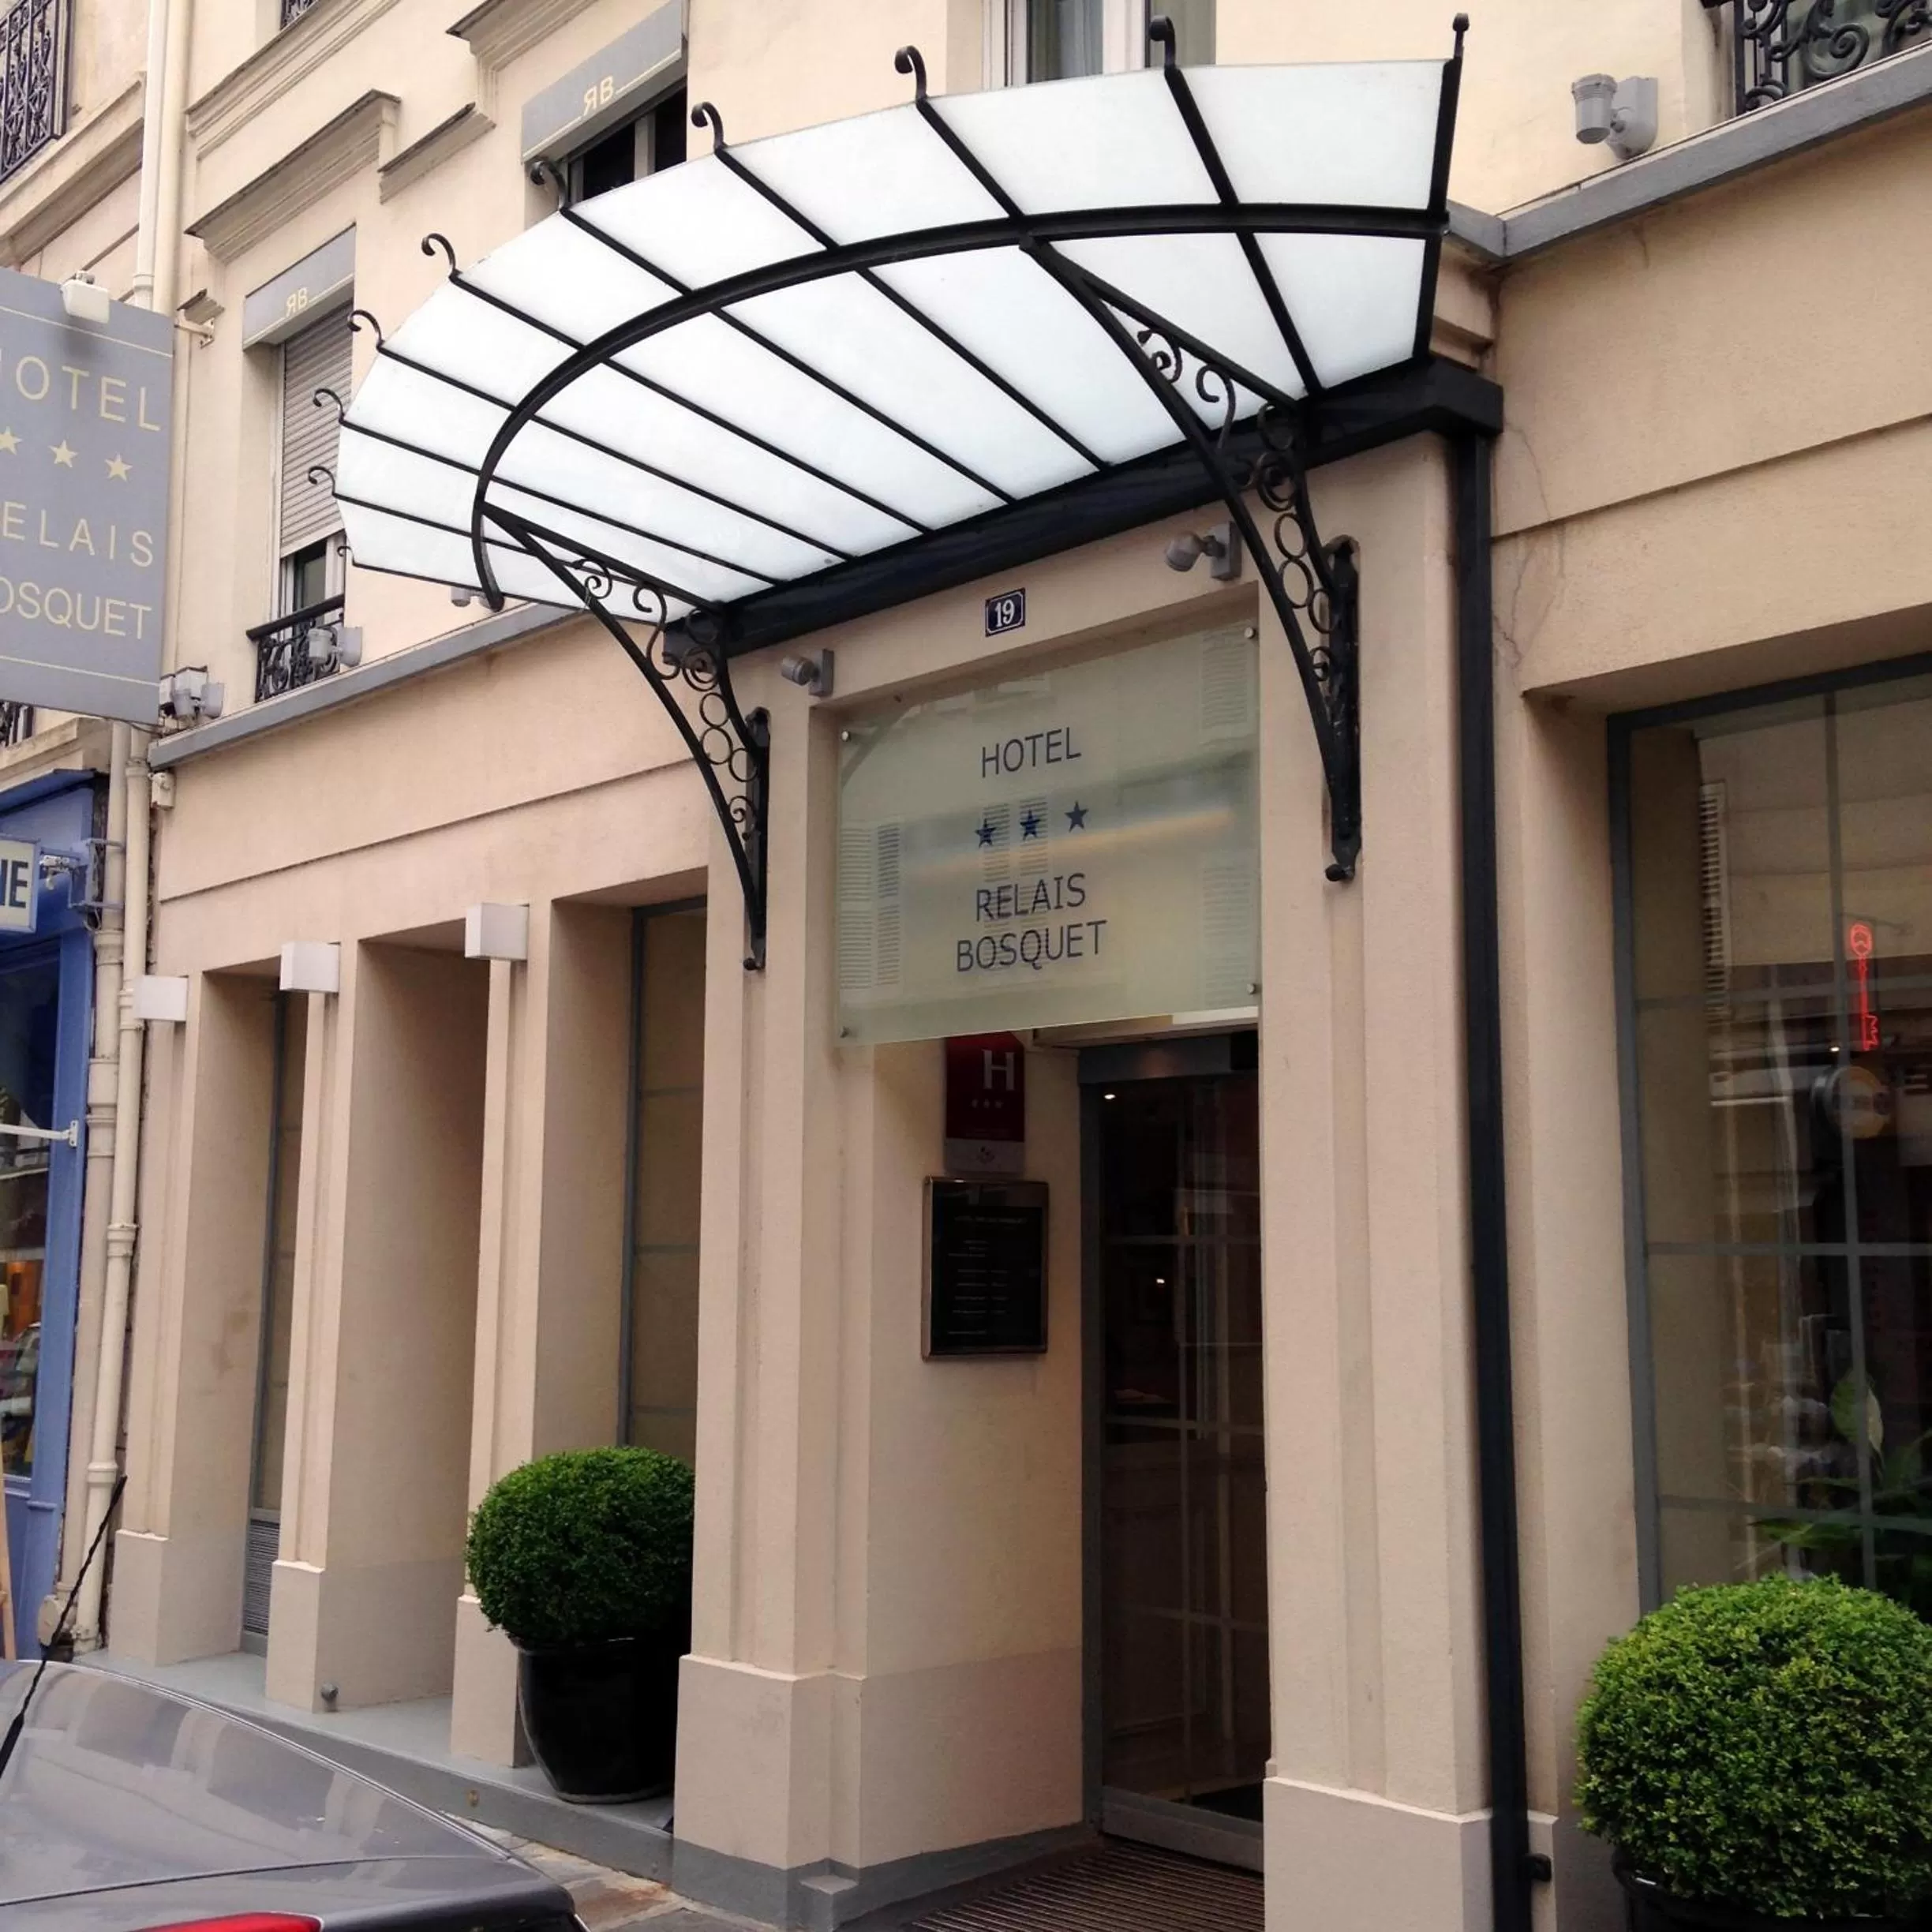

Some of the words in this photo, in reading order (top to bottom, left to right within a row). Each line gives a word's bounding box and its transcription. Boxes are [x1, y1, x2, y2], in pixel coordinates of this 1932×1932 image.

[0, 349, 161, 432] OTEL
[994, 599, 1015, 627] 19
[981, 727, 1082, 778] HOTEL
[975, 873, 1087, 923] RELAIS
[957, 919, 1108, 972] BOSQUET
[982, 1049, 1016, 1091] H
